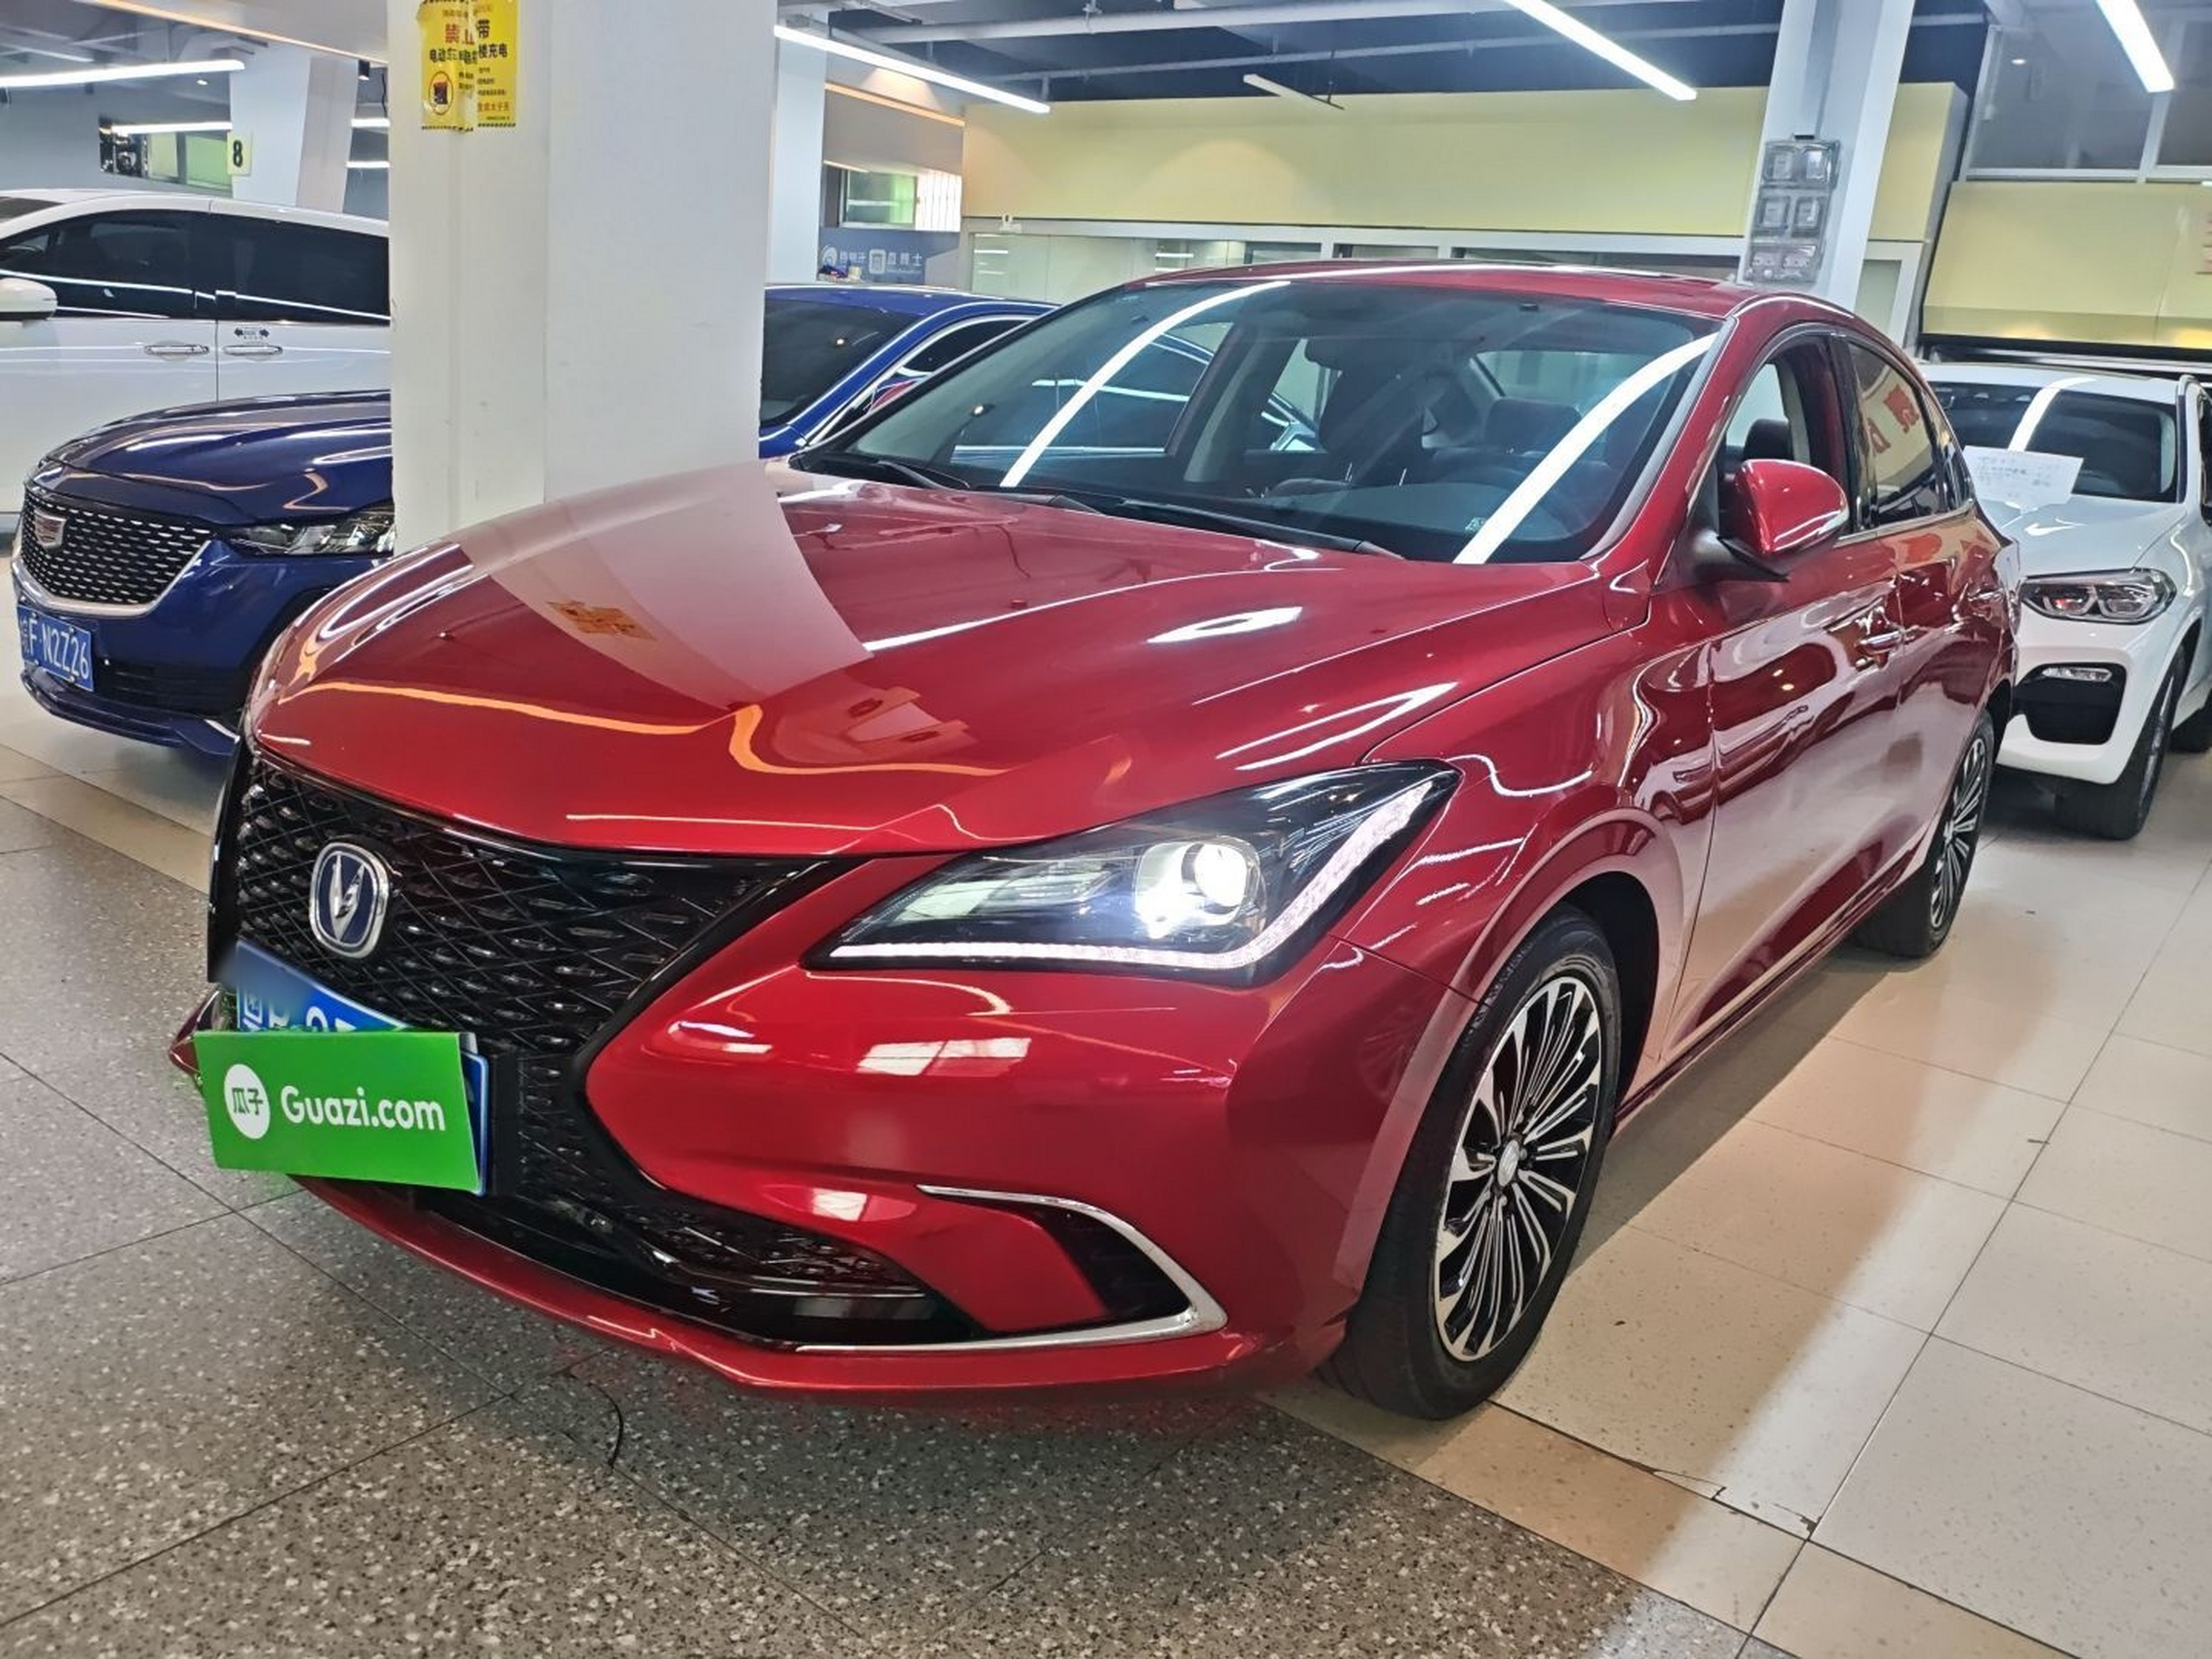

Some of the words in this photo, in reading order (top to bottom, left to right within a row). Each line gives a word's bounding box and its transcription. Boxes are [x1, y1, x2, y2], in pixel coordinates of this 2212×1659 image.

[233, 140, 243, 168] 8
[232, 1087, 263, 1116] 瓜子
[281, 1085, 445, 1131] Guazi.com
